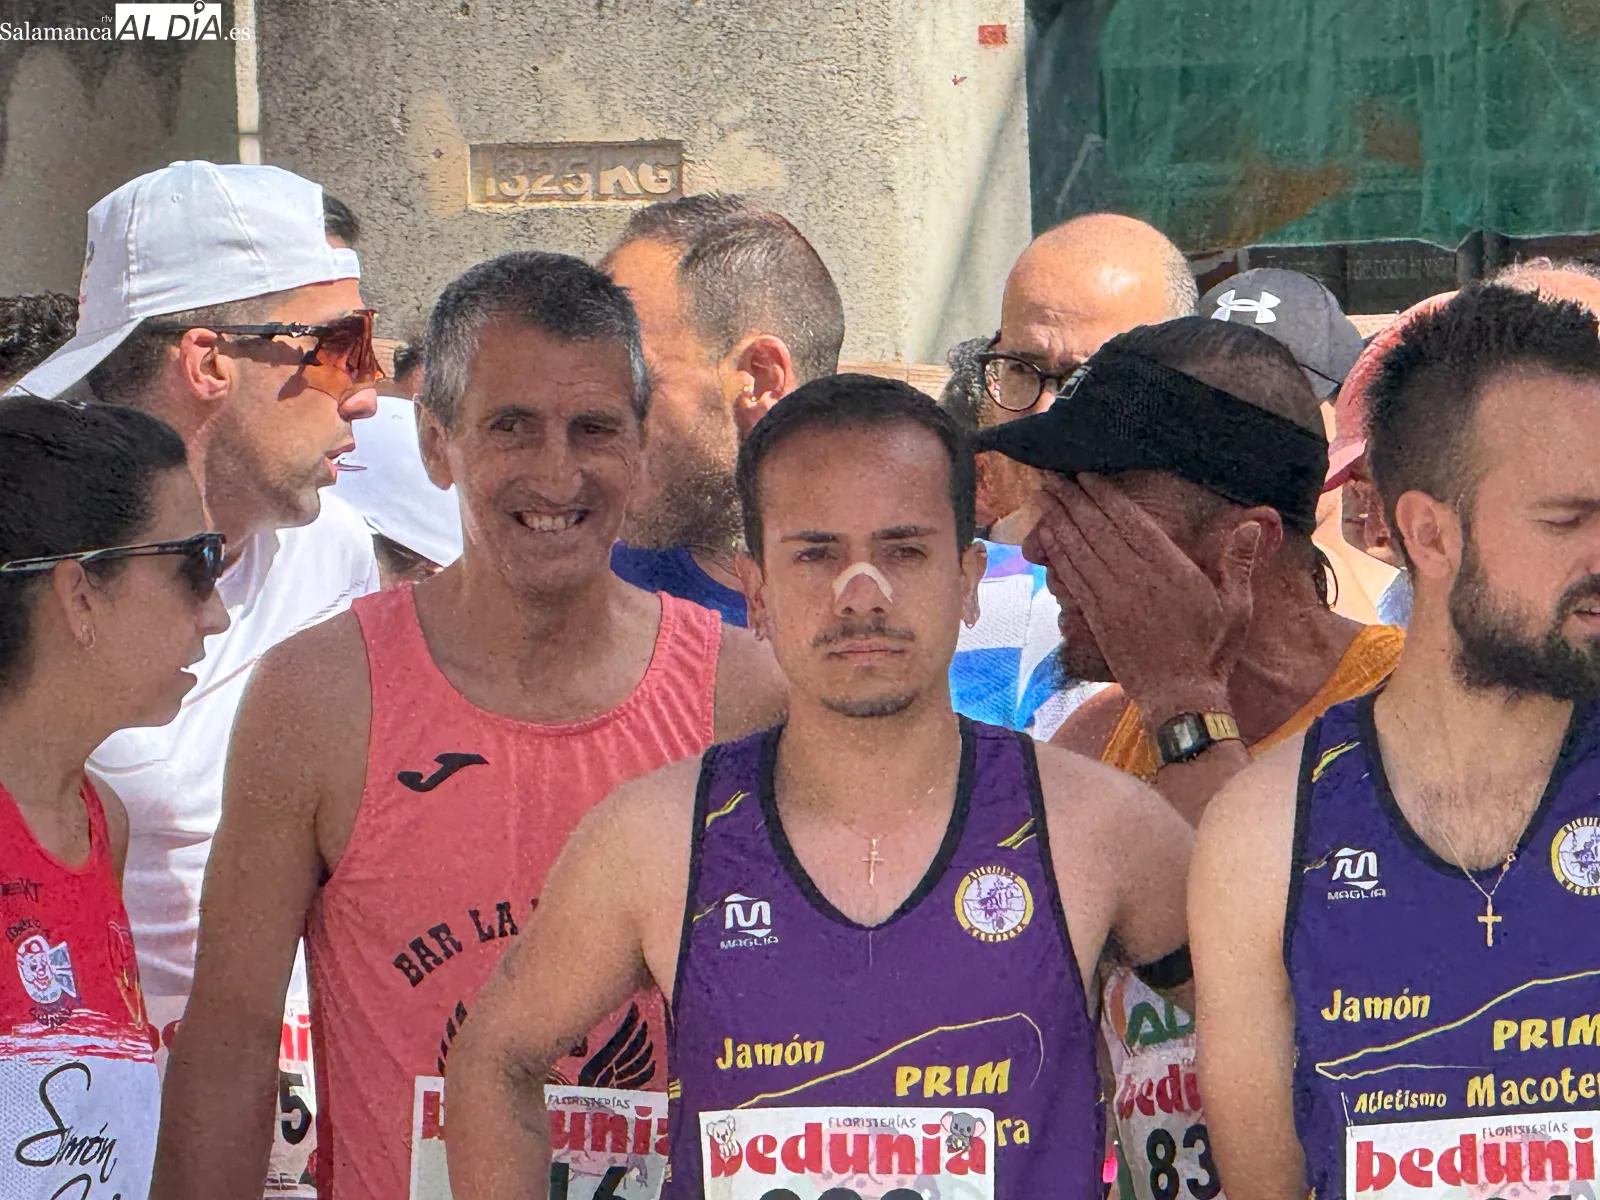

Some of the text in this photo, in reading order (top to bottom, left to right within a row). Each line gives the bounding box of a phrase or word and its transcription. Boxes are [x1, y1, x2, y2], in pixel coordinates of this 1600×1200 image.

[1327, 888, 1387, 901] MAGLIA
[392, 901, 520, 988] BAR LA
[720, 936, 779, 950] MAGLIA
[1321, 987, 1431, 1022] Jamón
[1493, 1013, 1600, 1052] PRIM
[716, 1033, 825, 1070] Jamón
[895, 1057, 1012, 1099] PRIM
[1353, 1067, 1600, 1114] Atletismo Macote
[828, 1115, 917, 1130] FLORISTERÍAS
